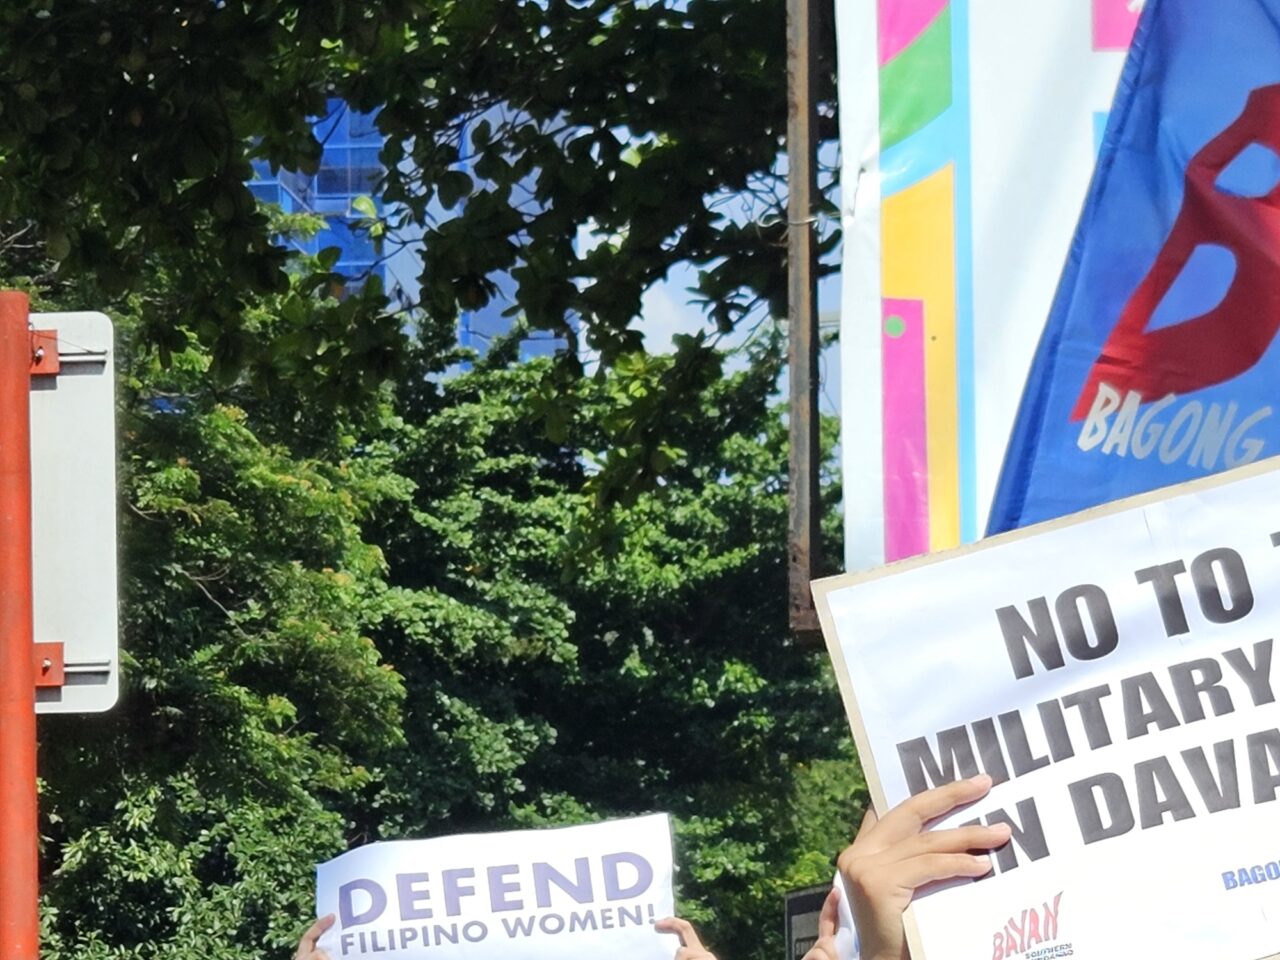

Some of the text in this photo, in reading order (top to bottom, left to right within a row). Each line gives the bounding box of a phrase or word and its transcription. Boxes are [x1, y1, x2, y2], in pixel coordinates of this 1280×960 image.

[1077, 382, 1272, 470] BAGONG
[994, 582, 1120, 680] NO
[1136, 546, 1254, 640] TO
[896, 636, 1276, 798] MILITARY
[339, 851, 654, 930] DEFEND
[340, 904, 656, 956] FILIPINO WOMEN!
